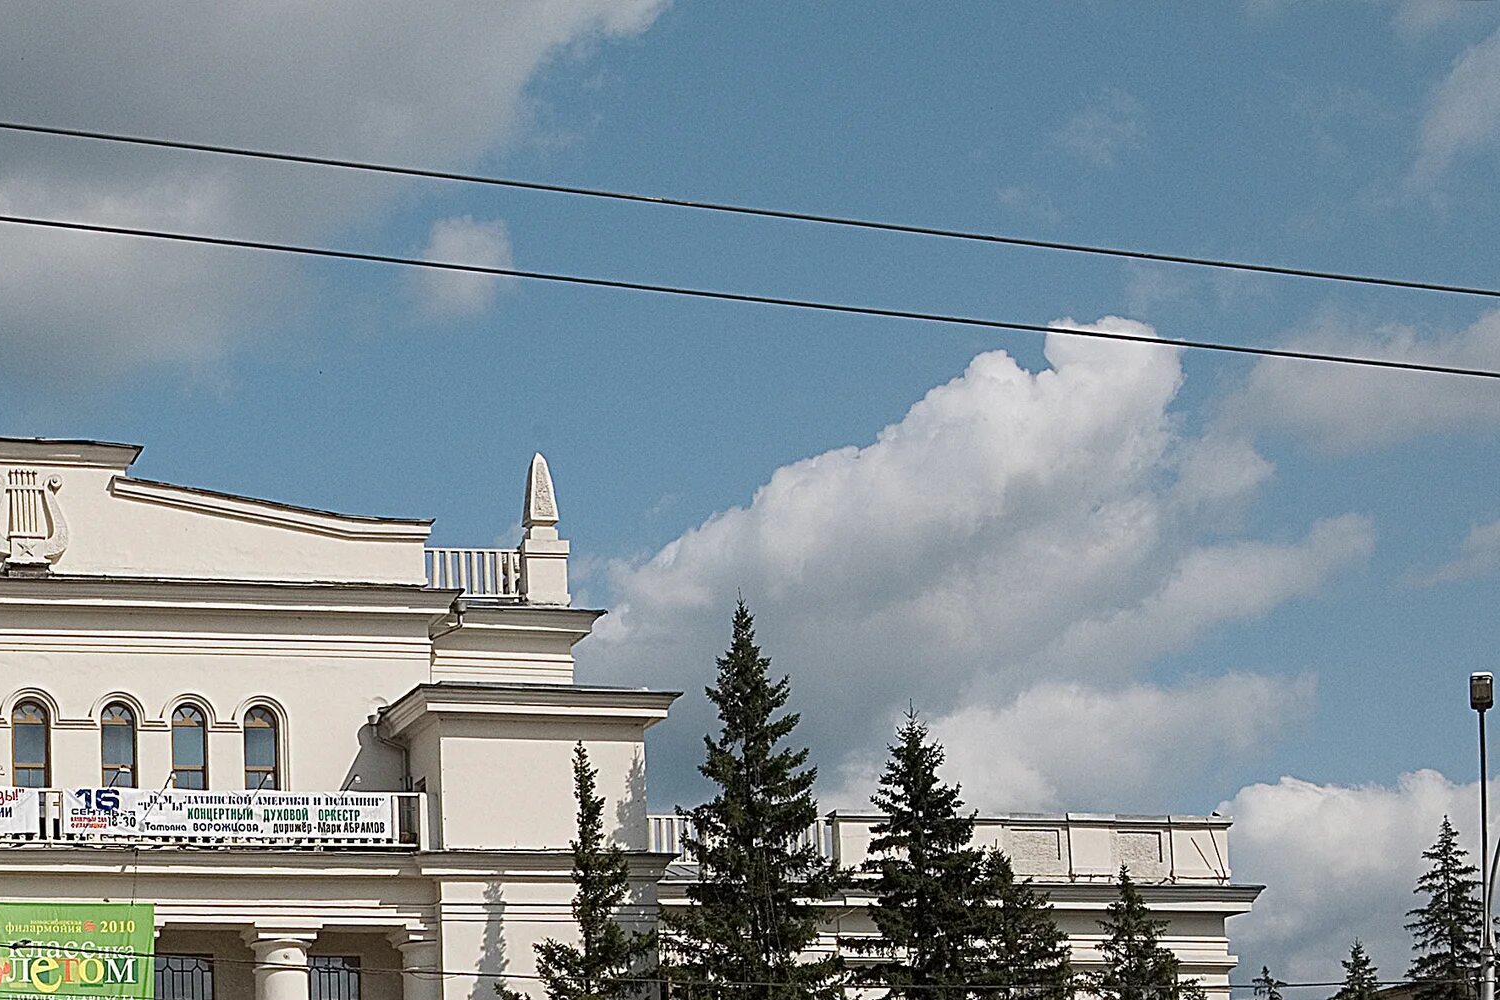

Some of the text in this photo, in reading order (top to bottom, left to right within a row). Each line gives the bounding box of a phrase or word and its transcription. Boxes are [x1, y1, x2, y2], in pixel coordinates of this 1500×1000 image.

[183, 795, 252, 805] ЛАТИНСКОЙ
[255, 796, 310, 806] АМЕРИКИ
[313, 796, 322, 806] И
[187, 807, 361, 822] КОНЦЕРТНЫЙ ДУХОВОЙ ОРКЕСТР
[107, 816, 136, 828] 18-30
[144, 822, 187, 831] Татьяна
[193, 822, 264, 833] ВОРОЖЦОВА,
[318, 822, 341, 835] Марк
[343, 822, 385, 833] АБРАМОВ
[5, 920, 136, 934] филармония 2010
